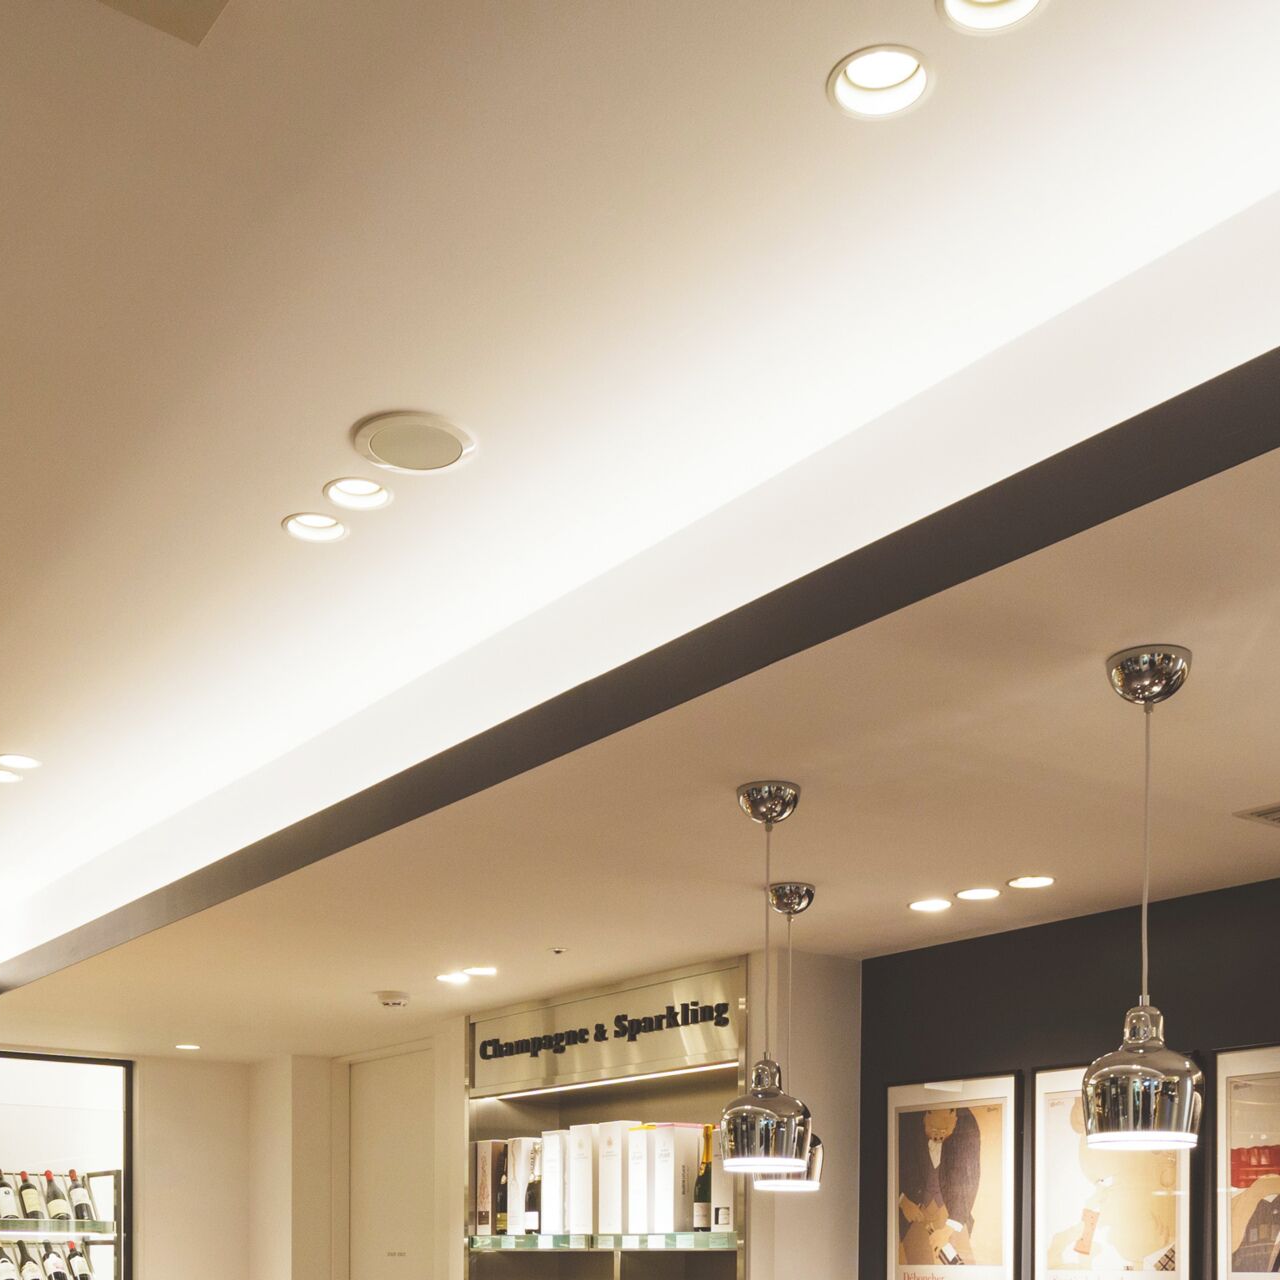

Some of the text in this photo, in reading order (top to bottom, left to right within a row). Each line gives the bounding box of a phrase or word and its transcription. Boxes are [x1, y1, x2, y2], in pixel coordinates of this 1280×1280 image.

[479, 1001, 730, 1060] Champagne & Sparkling
